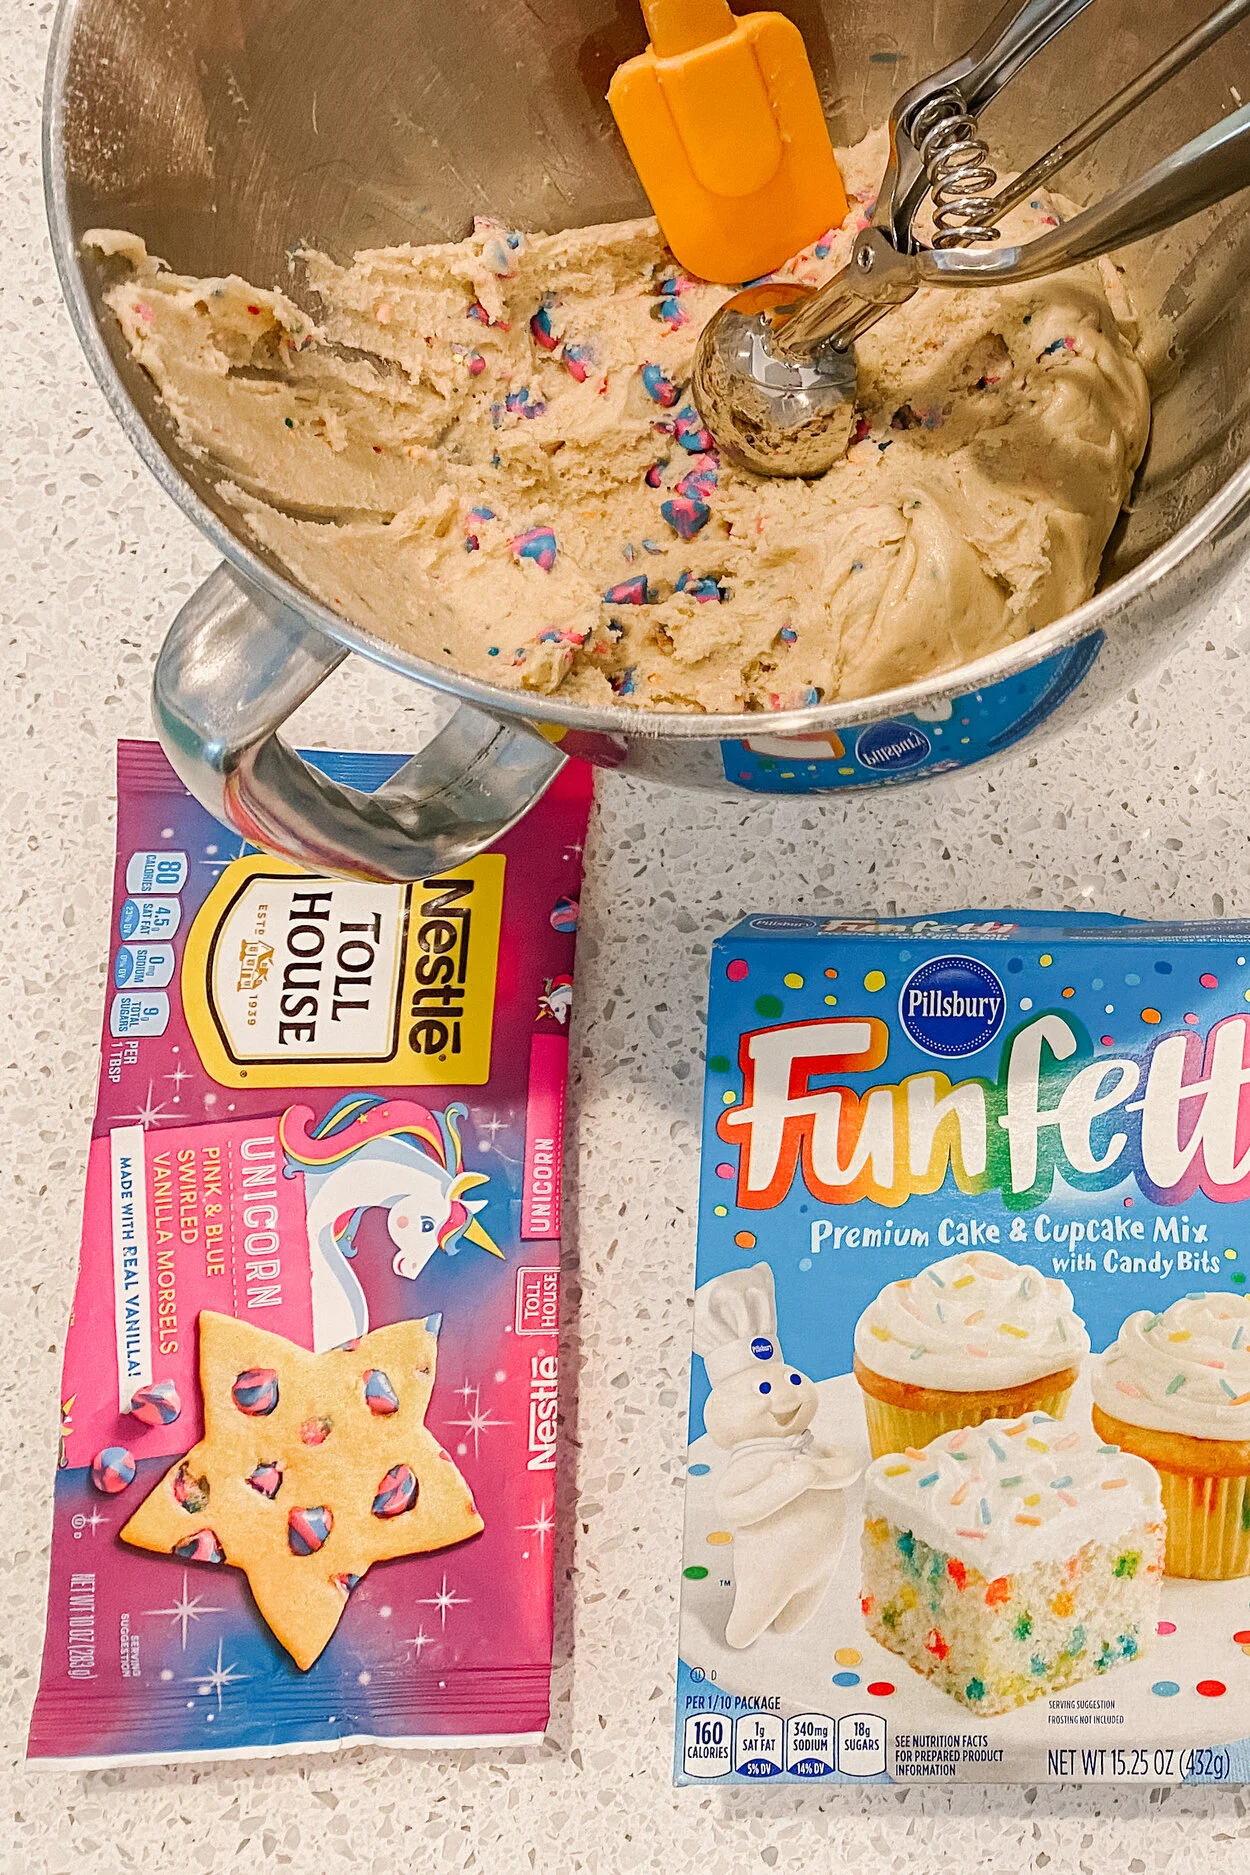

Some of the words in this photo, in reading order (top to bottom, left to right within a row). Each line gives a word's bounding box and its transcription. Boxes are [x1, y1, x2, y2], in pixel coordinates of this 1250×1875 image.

[141, 854, 156, 892] CALORIES
[155, 861, 182, 885] 80
[142, 903, 152, 918] SAT
[151, 906, 171, 932] 4.5g
[140, 920, 150, 935] FAT
[134, 950, 148, 983] SODIUM
[279, 891, 333, 1045] HOUSE
[332, 912, 381, 1021] TOLL
[409, 879, 475, 1055] Nestlé
[118, 998, 132, 1032] SUGARS
[129, 1001, 142, 1028] TOTAL
[247, 995, 258, 1025] 1939
[908, 988, 1001, 1025] Pillsbury
[108, 1051, 122, 1083] TBSP
[124, 1040, 139, 1064] PER
[120, 1157, 132, 1200] MADE
[202, 1147, 222, 1196] PINK
[530, 1138, 554, 1232] UNICORN
[153, 1152, 174, 1245] VANILLA
[178, 1150, 199, 1244] SWIRLED
[204, 1204, 222, 1218] &
[121, 1203, 134, 1240] WITH
[240, 1136, 282, 1309] UNICORN
[811, 1218, 929, 1253] Premium
[938, 1216, 1000, 1247] Cake
[1009, 1217, 1027, 1243] &
[1034, 1216, 1145, 1252] Cupcake
[1153, 1215, 1208, 1244] Mix
[205, 1224, 224, 1277] BLUE
[1052, 1252, 1097, 1274] with
[1103, 1249, 1174, 1280] Candy
[1178, 1250, 1221, 1274] Bits
[122, 1246, 139, 1290] REAL
[157, 1250, 178, 1354] MORSELS
[524, 1281, 540, 1320] TOLL
[541, 1273, 558, 1328] HOUSE
[125, 1294, 140, 1377] VANILLA!
[528, 1356, 558, 1470] Nestlé
[70, 1574, 96, 1592] NET
[69, 1594, 95, 1612] WT
[69, 1615, 94, 1627] 10
[69, 1629, 94, 1644] OZ
[120, 1613, 131, 1678] SUGGESTION
[130, 1635, 142, 1676] SERVING
[686, 1696, 706, 1710] PER
[708, 1695, 732, 1710] 1/10
[734, 1696, 780, 1710] PACKAGE
[1048, 1700, 1076, 1710] SERVING
[1076, 1700, 1116, 1710] SUGGESTION
[694, 1721, 723, 1745] 160
[754, 1722, 765, 1738] 1g
[793, 1722, 828, 1738] 340mg
[854, 1722, 871, 1738] 18g
[1048, 1715, 1079, 1724] FROSTING
[1080, 1715, 1092, 1724] NOT
[1094, 1715, 1124, 1724] INCLUDED
[687, 1746, 729, 1759] CALORIES
[742, 1738, 758, 1751] SAT
[760, 1738, 776, 1752] FAT
[793, 1738, 828, 1752] SODIUM
[844, 1738, 880, 1752] SUGARS
[895, 1735, 910, 1748] SEE
[912, 1735, 959, 1748] NUTRITION
[962, 1735, 988, 1748] FACTS
[895, 1750, 912, 1762] FOR
[915, 1750, 960, 1762] PREPARED
[962, 1750, 1004, 1762] PRODUCT
[747, 1762, 760, 1774] 5%
[761, 1762, 772, 1774] DV
[798, 1762, 812, 1774] 14%
[813, 1762, 824, 1774] DV
[895, 1764, 956, 1776] INFORMATION
[1048, 1750, 1076, 1776] NET
[1082, 1750, 1106, 1776] WT
[1111, 1750, 1149, 1776] 15.25
[1154, 1750, 1174, 1776] OZ
[1179, 1749, 1230, 1779] (432g)
